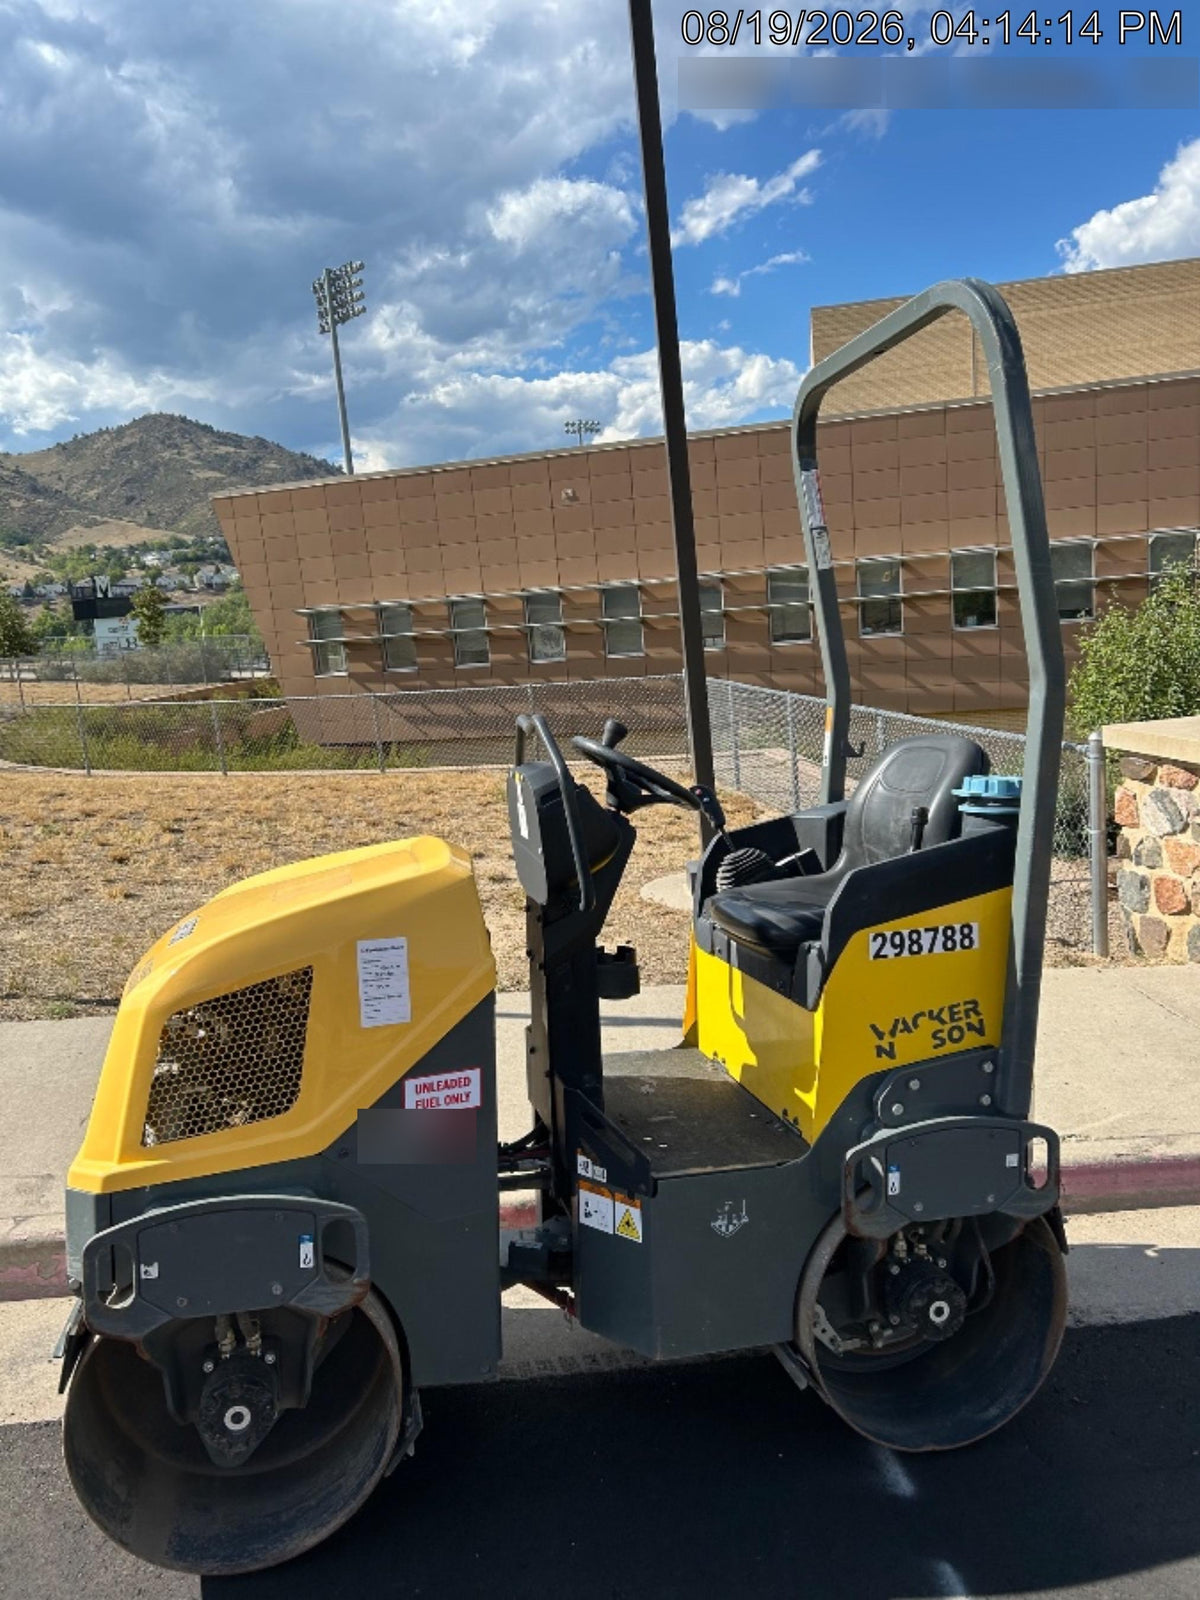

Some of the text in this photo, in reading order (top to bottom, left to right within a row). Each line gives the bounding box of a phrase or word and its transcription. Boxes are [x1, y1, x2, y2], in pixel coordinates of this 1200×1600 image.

[93, 575, 112, 598] M
[872, 923, 974, 960] 298788
[415, 1076, 471, 1095] UNLEADED
[415, 1091, 471, 1109] FUEL ONLY
